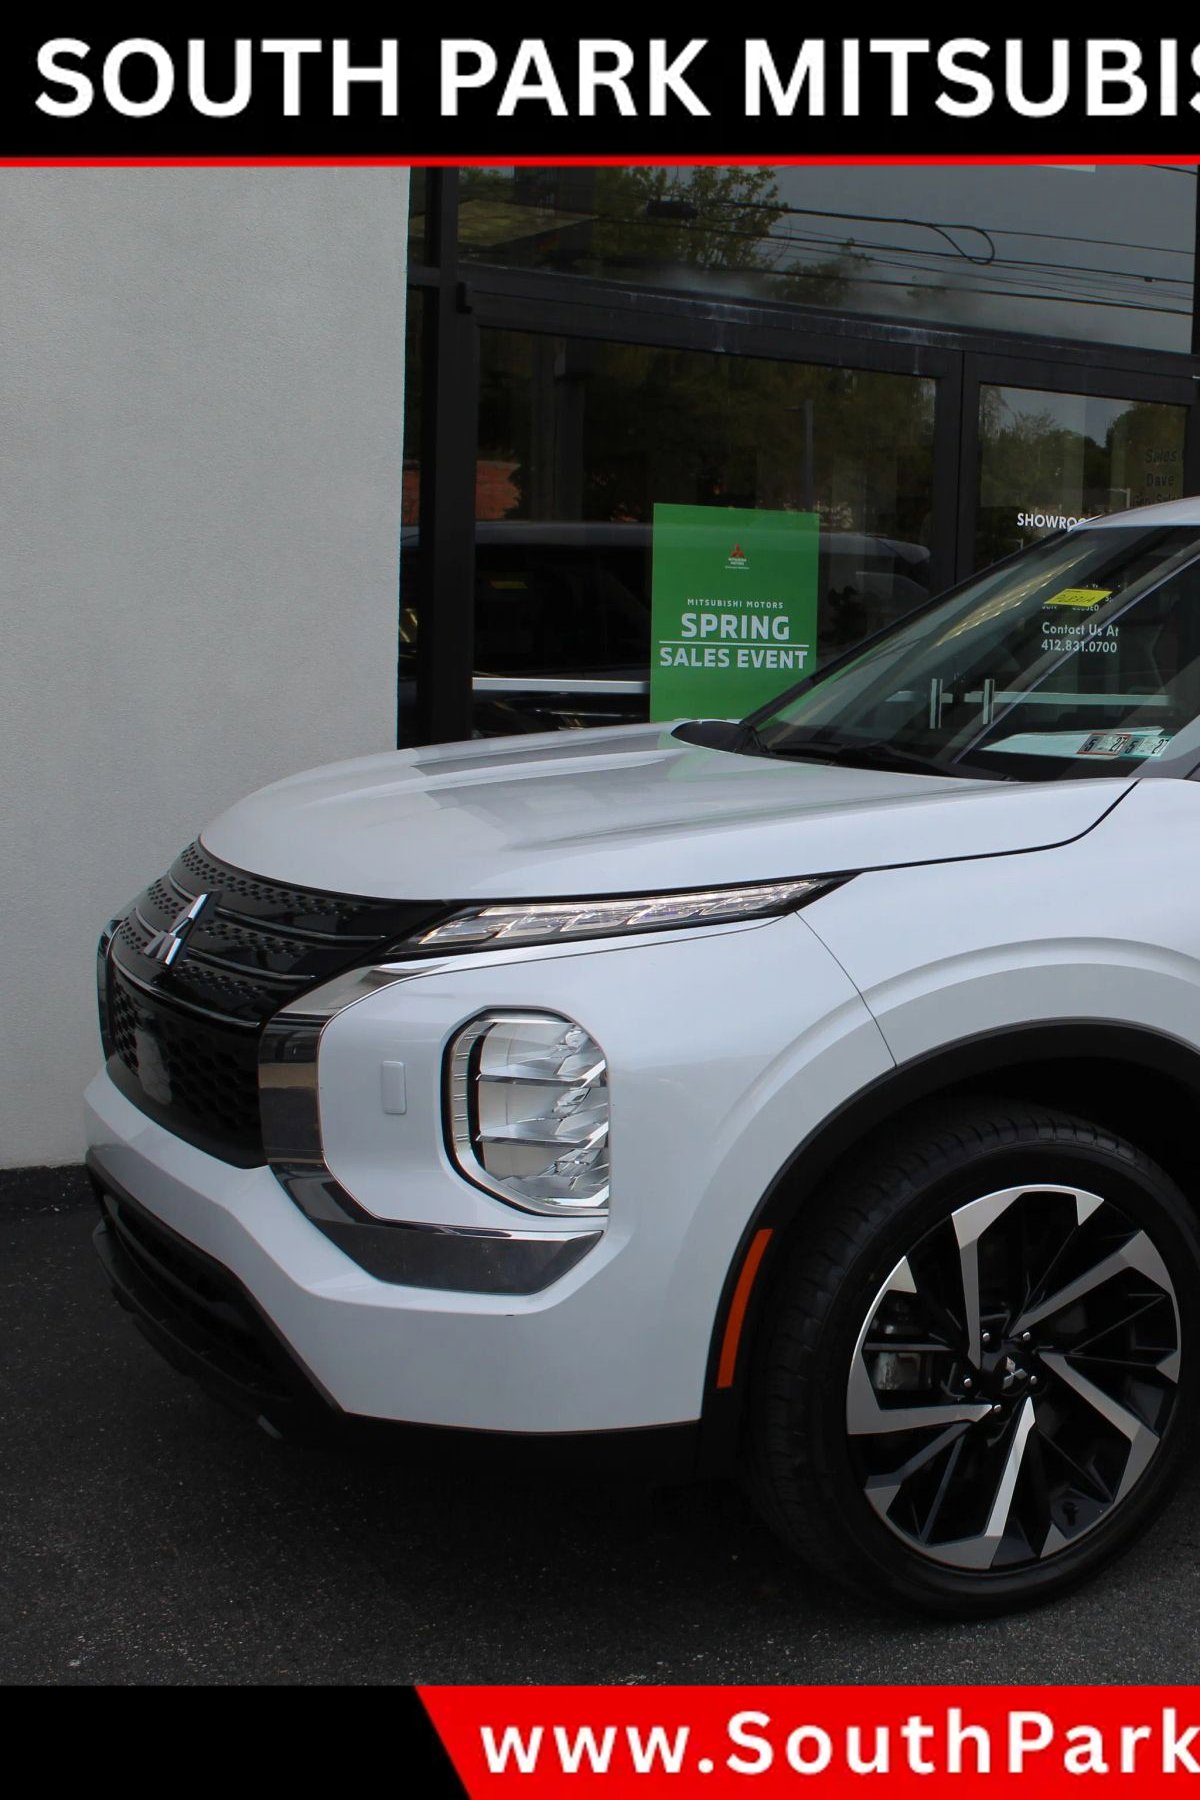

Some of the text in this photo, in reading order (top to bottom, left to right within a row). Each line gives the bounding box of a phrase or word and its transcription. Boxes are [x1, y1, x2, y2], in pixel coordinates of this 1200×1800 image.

[687, 598, 784, 609] MITSUBISHI MOTORS
[681, 613, 790, 640] SPRING
[1042, 621, 1120, 637] Contact Us At
[1041, 638, 1118, 653] 412.831.0700
[659, 647, 808, 669] SALES EVENT
